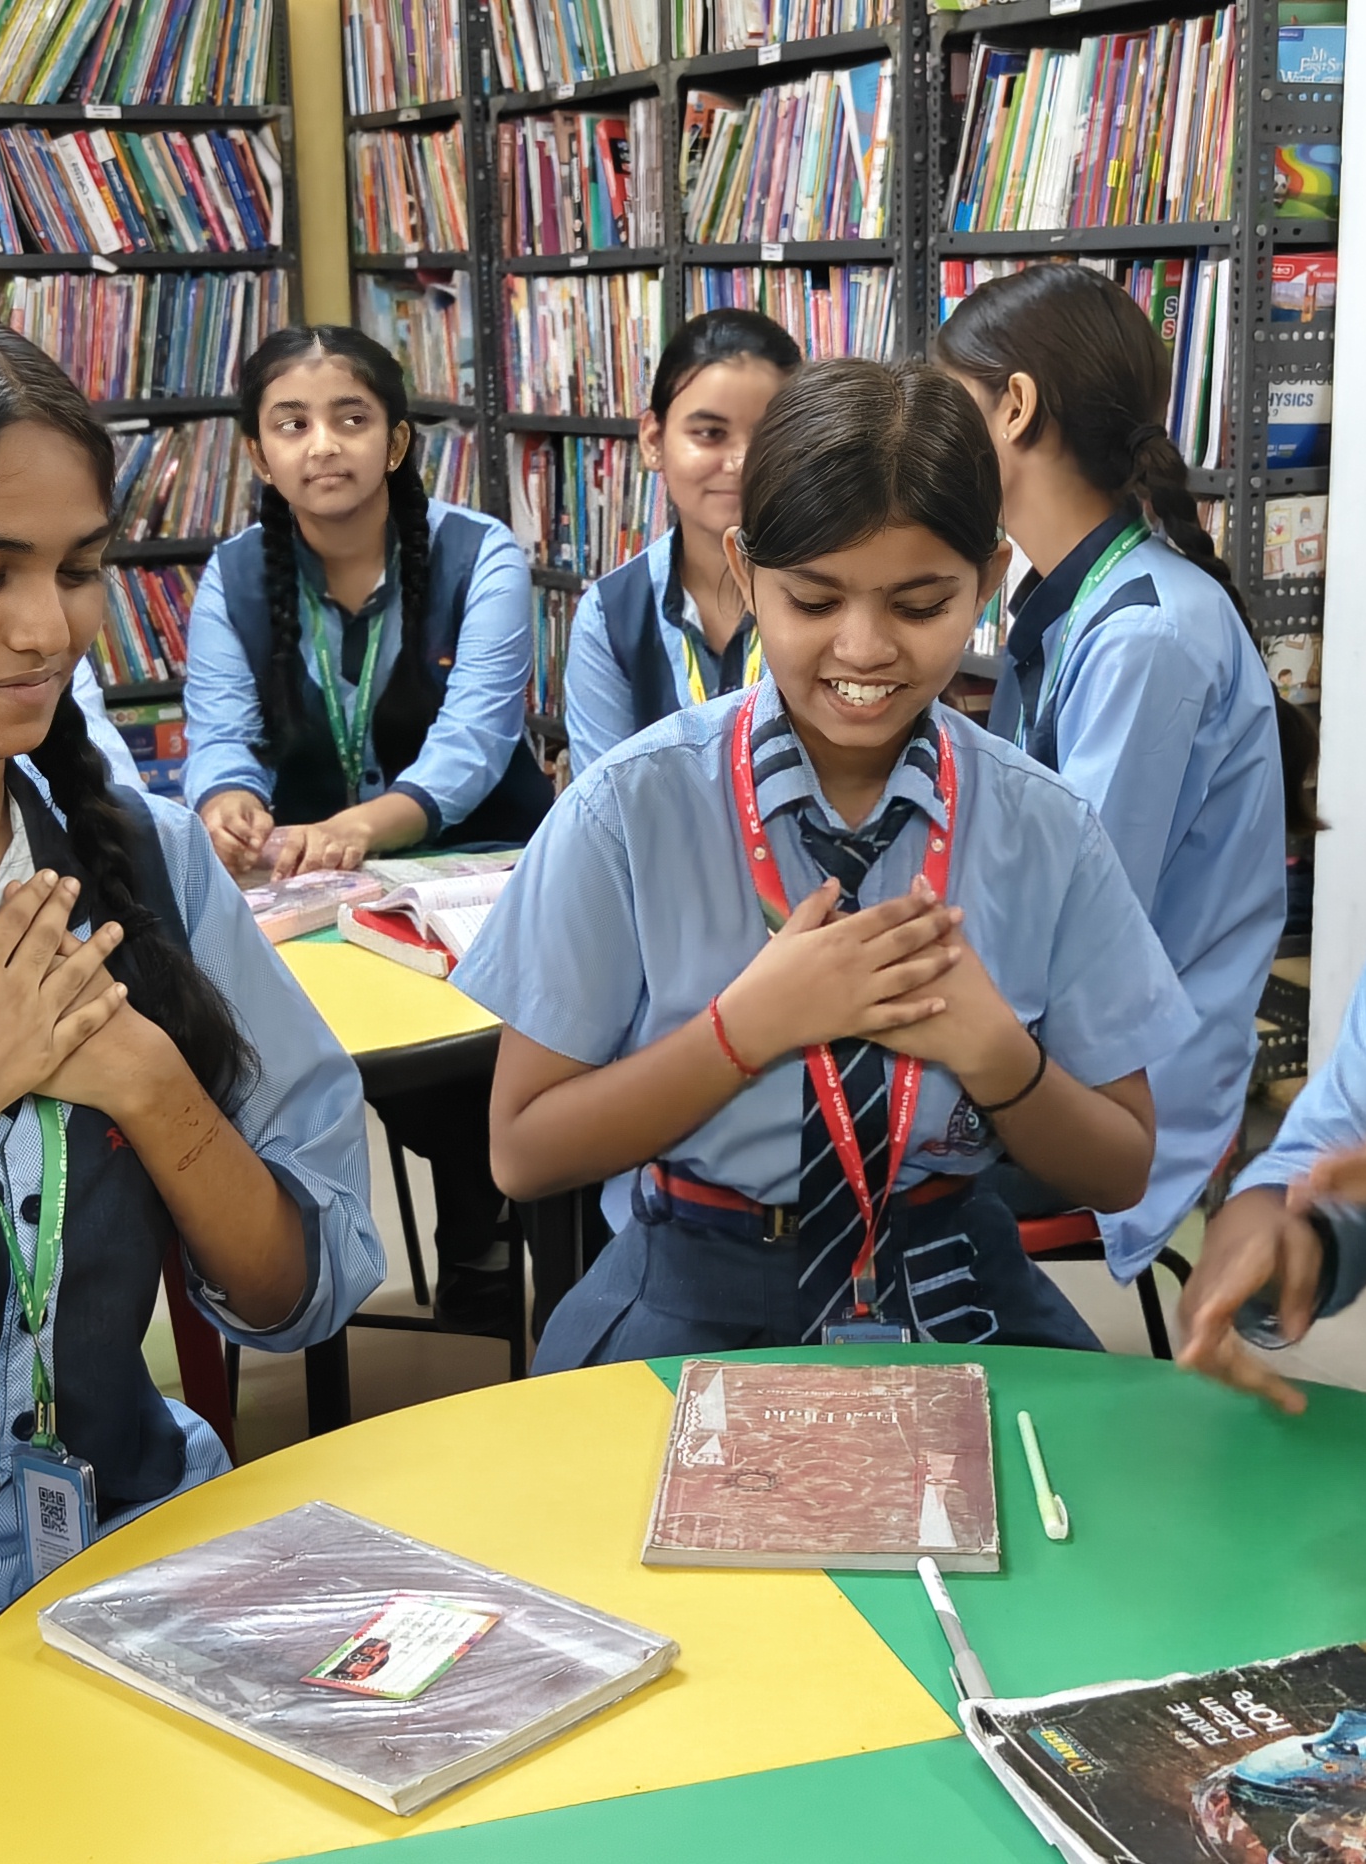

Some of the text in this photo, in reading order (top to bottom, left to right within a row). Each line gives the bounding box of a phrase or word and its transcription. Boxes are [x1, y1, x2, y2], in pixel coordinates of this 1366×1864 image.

[1269, 392, 1314, 407] HYSICS
[833, 1092, 852, 1142] English
[894, 1092, 910, 1142] English
[54, 1178, 67, 1241] English
[763, 1408, 898, 1424] First Flight
